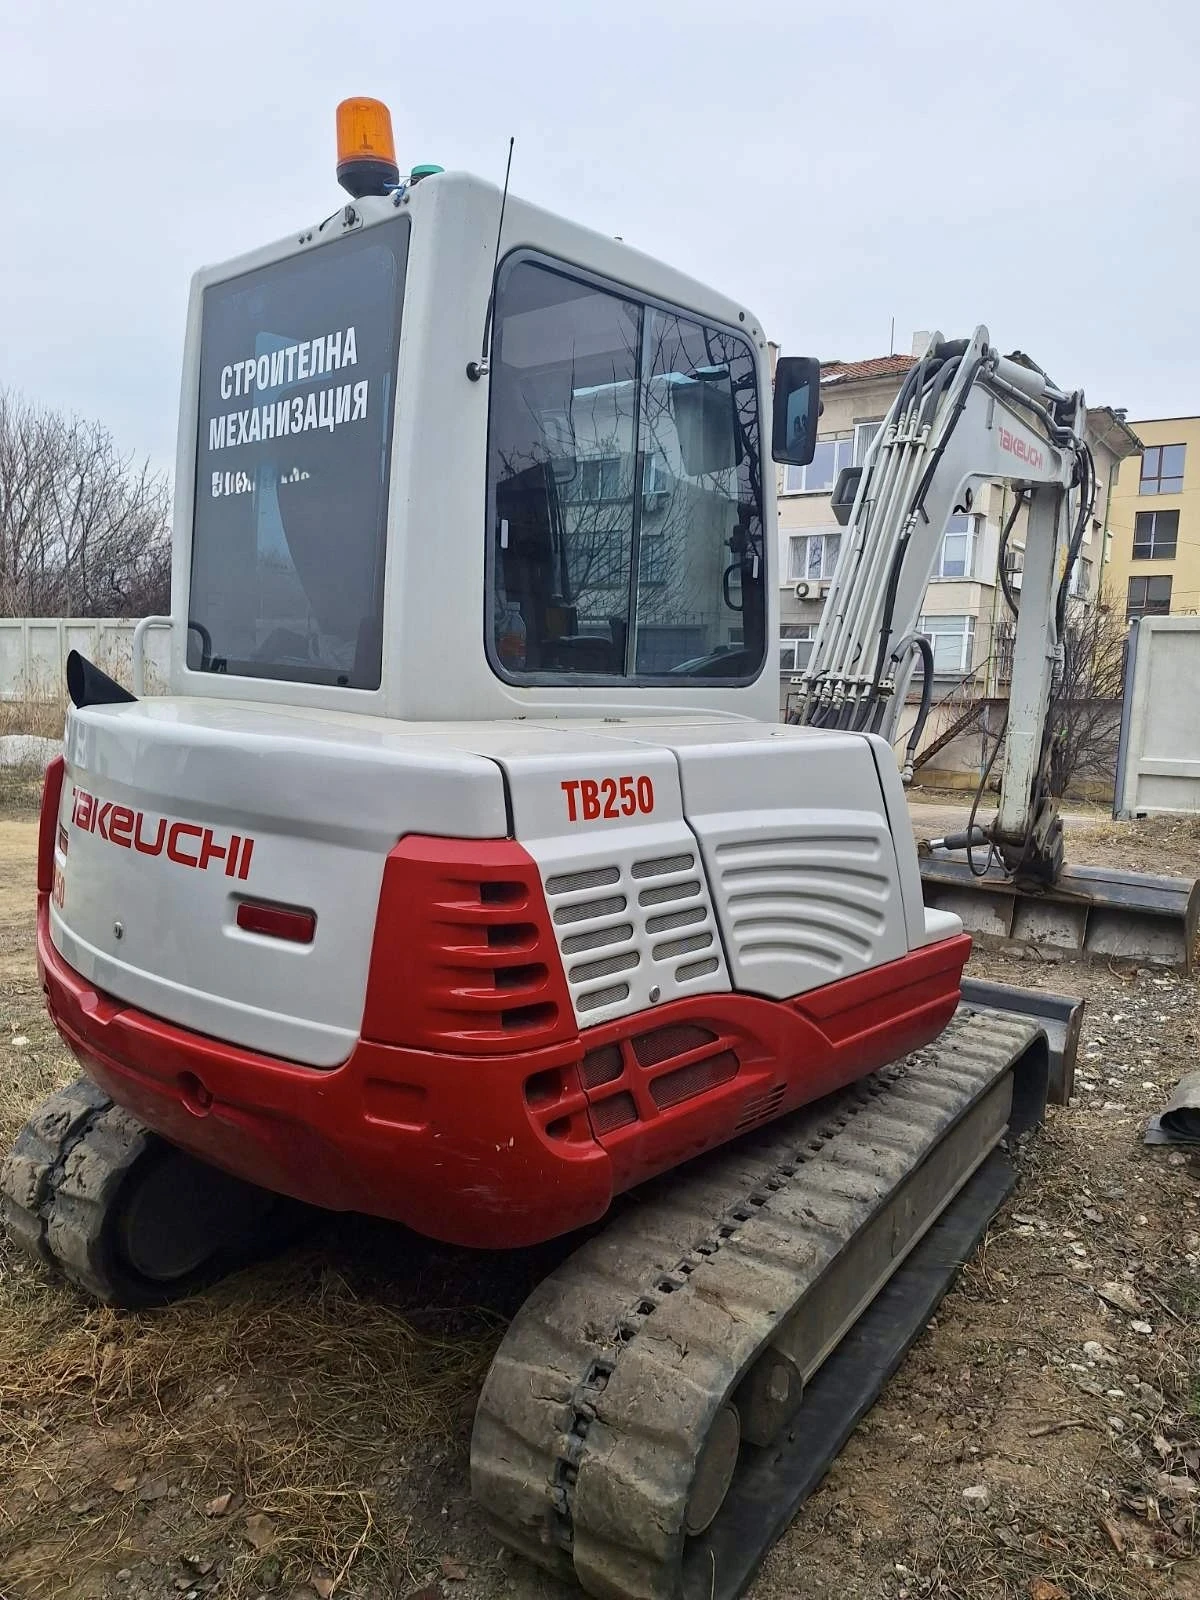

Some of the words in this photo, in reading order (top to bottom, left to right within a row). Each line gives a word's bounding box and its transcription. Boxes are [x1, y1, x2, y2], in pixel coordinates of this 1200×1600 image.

[220, 326, 358, 400] СТРОИТЕЛНА
[208, 379, 369, 451] МЕХАНИЗАЦИЯ
[560, 775, 655, 822] TB250
